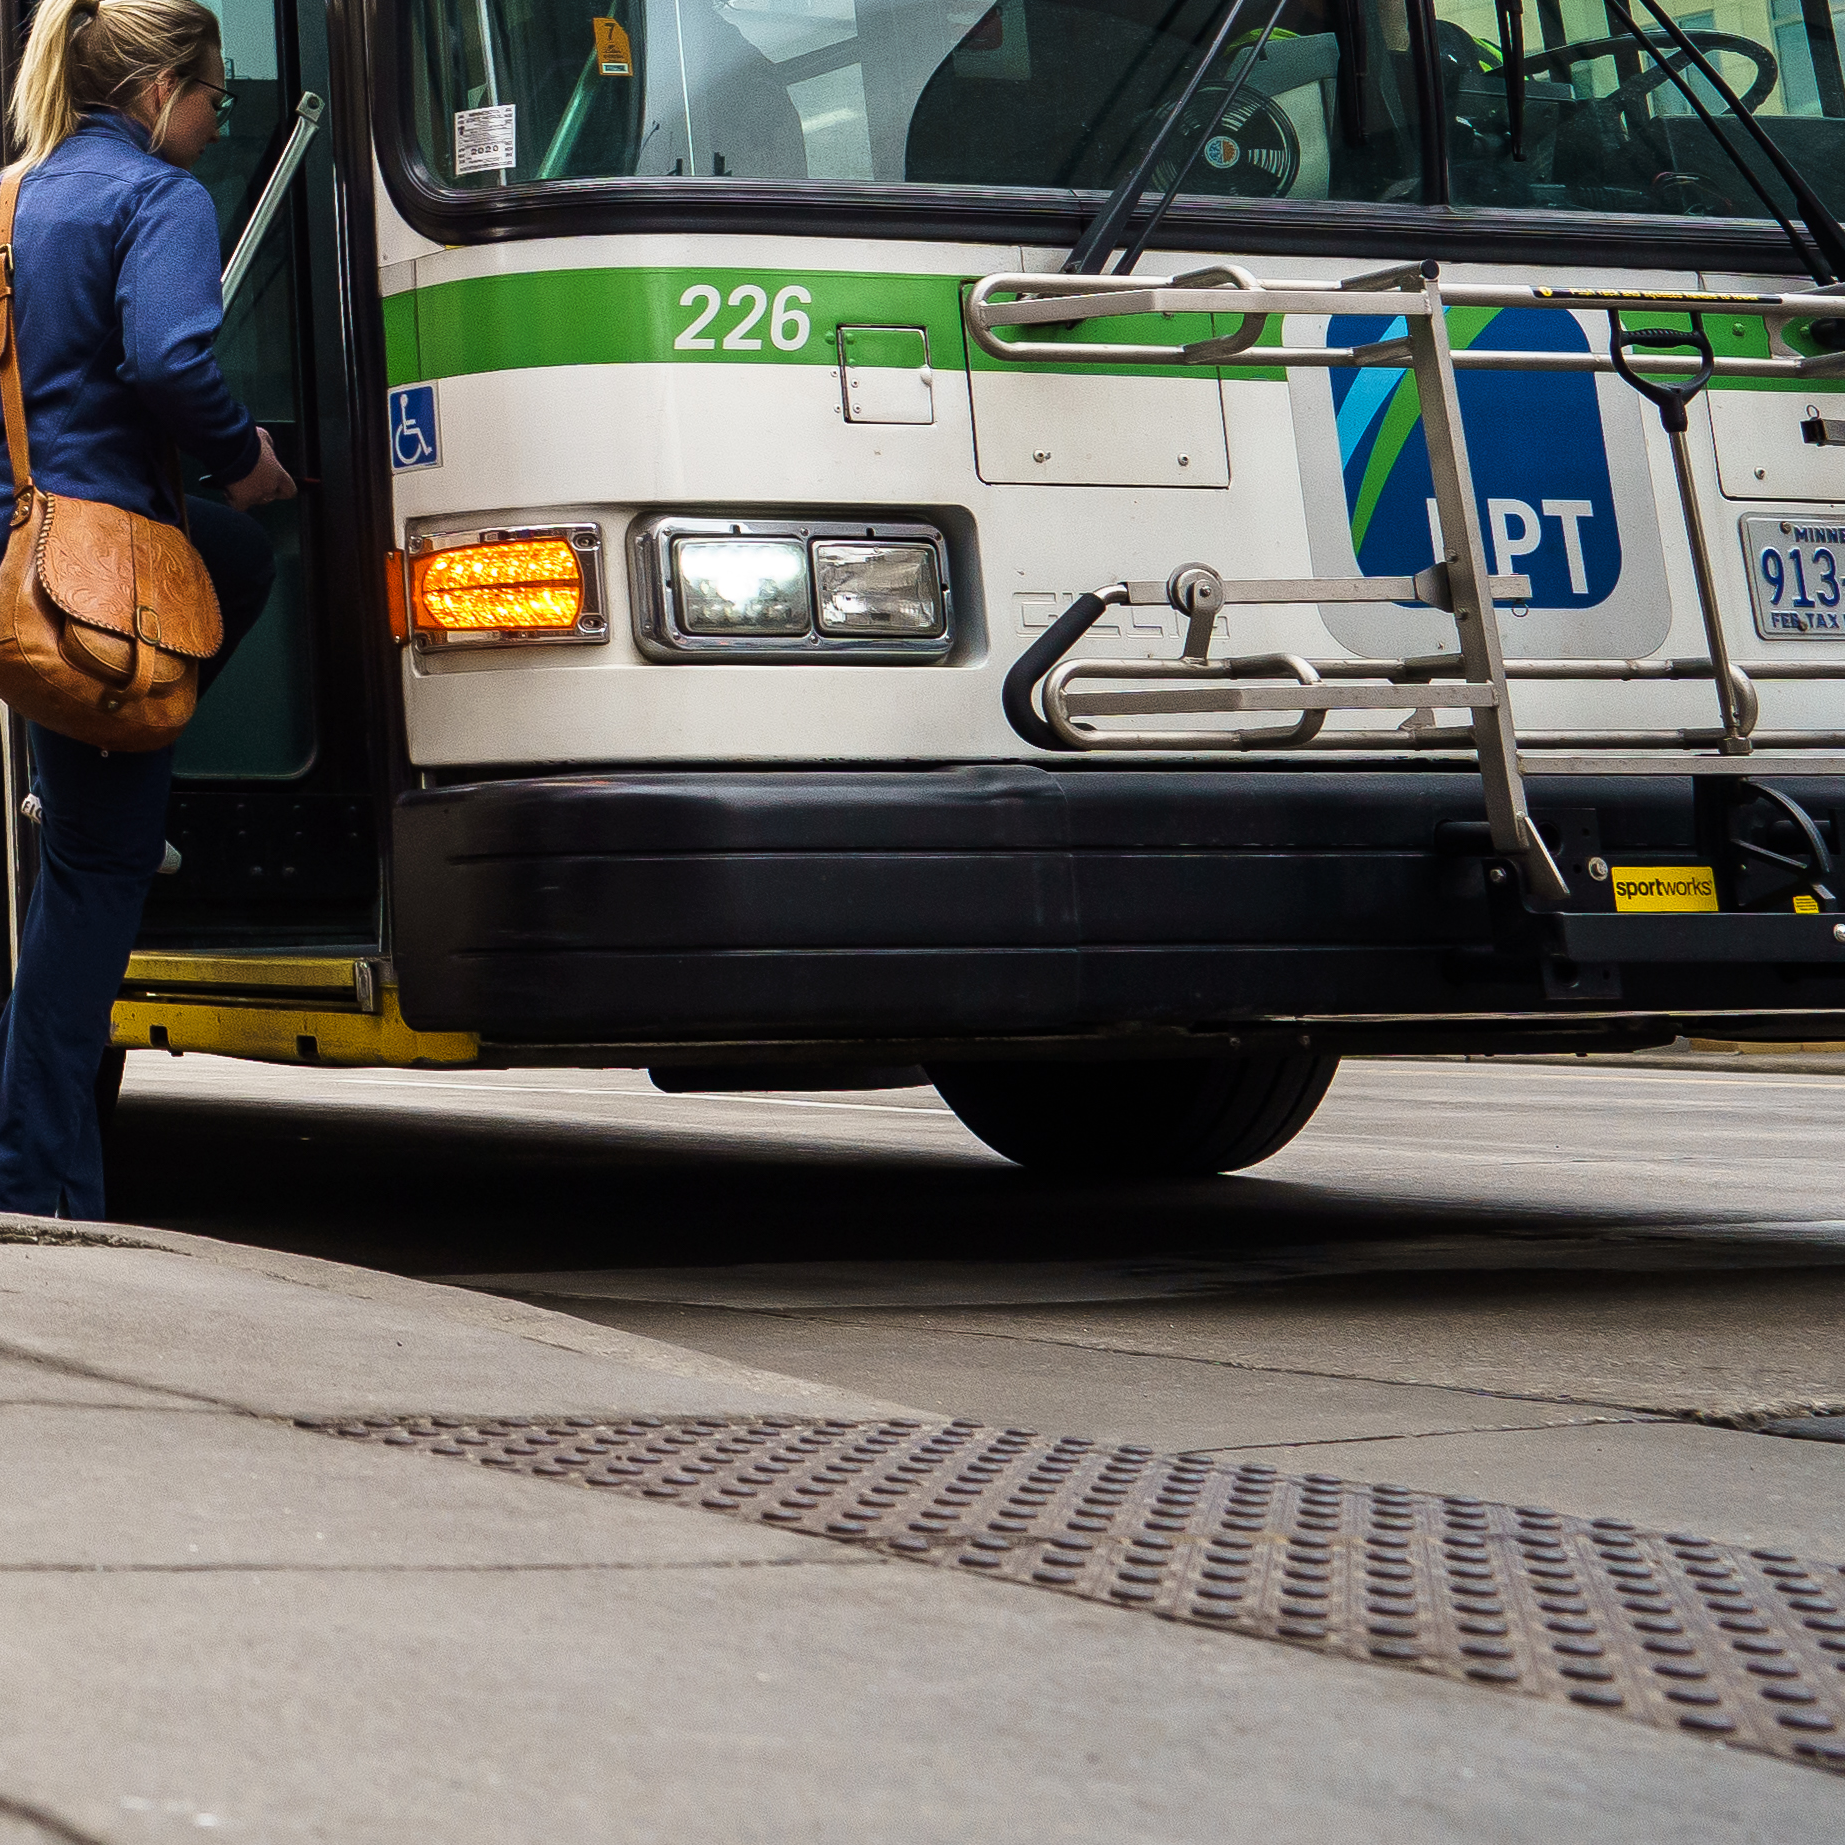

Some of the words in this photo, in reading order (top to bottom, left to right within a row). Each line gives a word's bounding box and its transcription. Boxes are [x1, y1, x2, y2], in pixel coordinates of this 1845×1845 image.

[673, 284, 812, 351] 226
[1425, 497, 1594, 594] PT
[1805, 611, 1840, 629] TAX
[1615, 876, 1712, 900] sportworks
